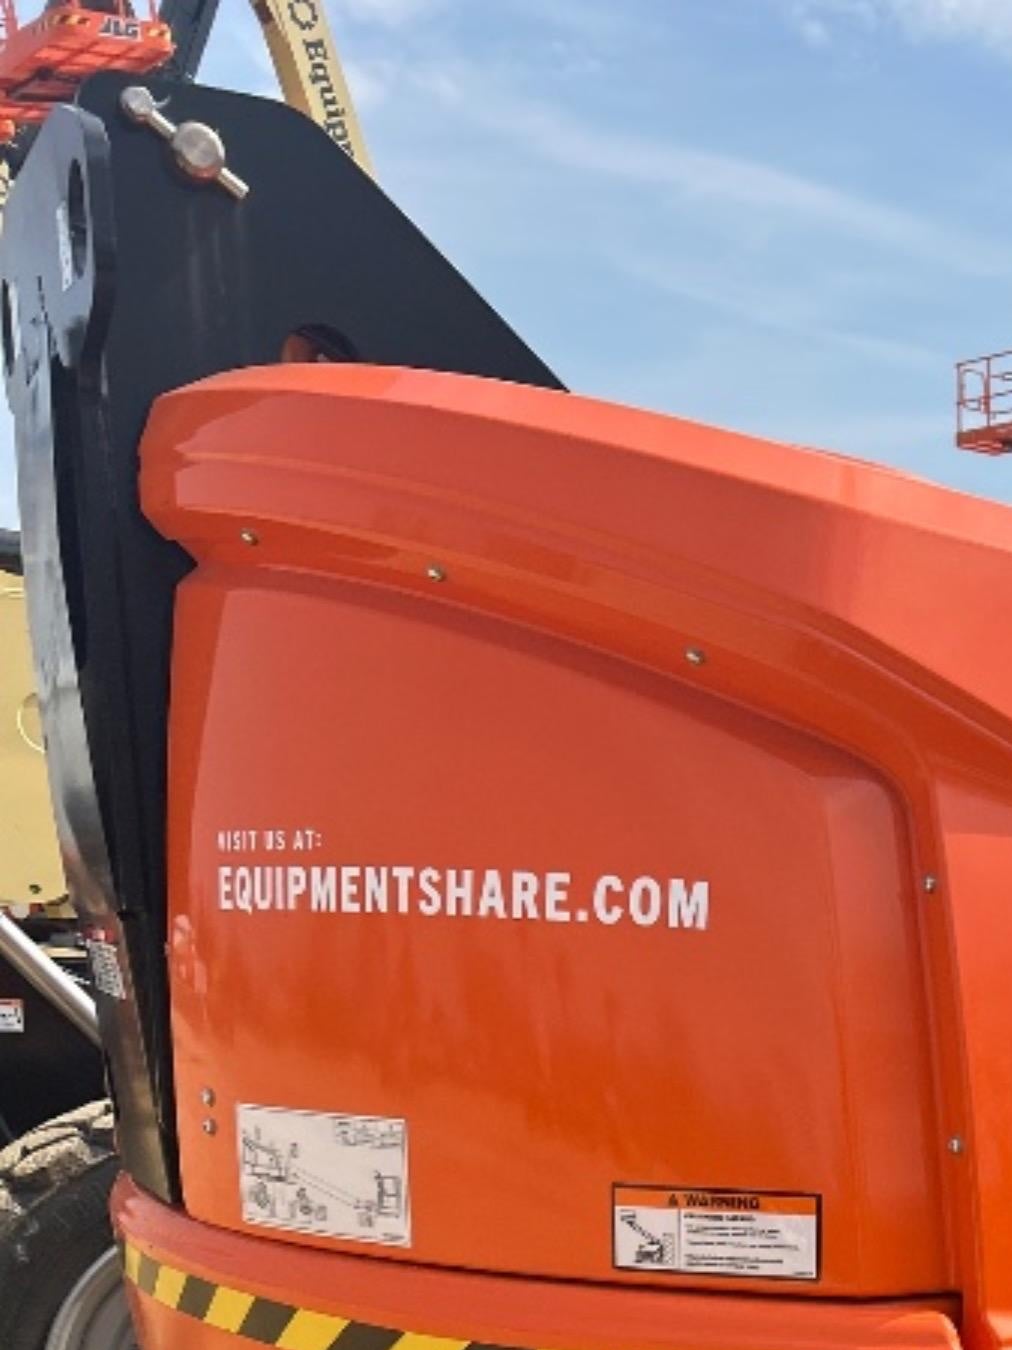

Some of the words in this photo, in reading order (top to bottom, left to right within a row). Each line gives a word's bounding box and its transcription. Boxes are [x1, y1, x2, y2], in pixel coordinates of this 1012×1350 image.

[99, 17, 139, 40] JLG
[302, 38, 355, 158] Equip
[217, 830, 257, 852] VISIT
[263, 830, 286, 851] US
[293, 829, 322, 851] AT:
[217, 866, 710, 930] EQUIPMENTSHARE.COM
[683, 1194, 760, 1210] WARNING
